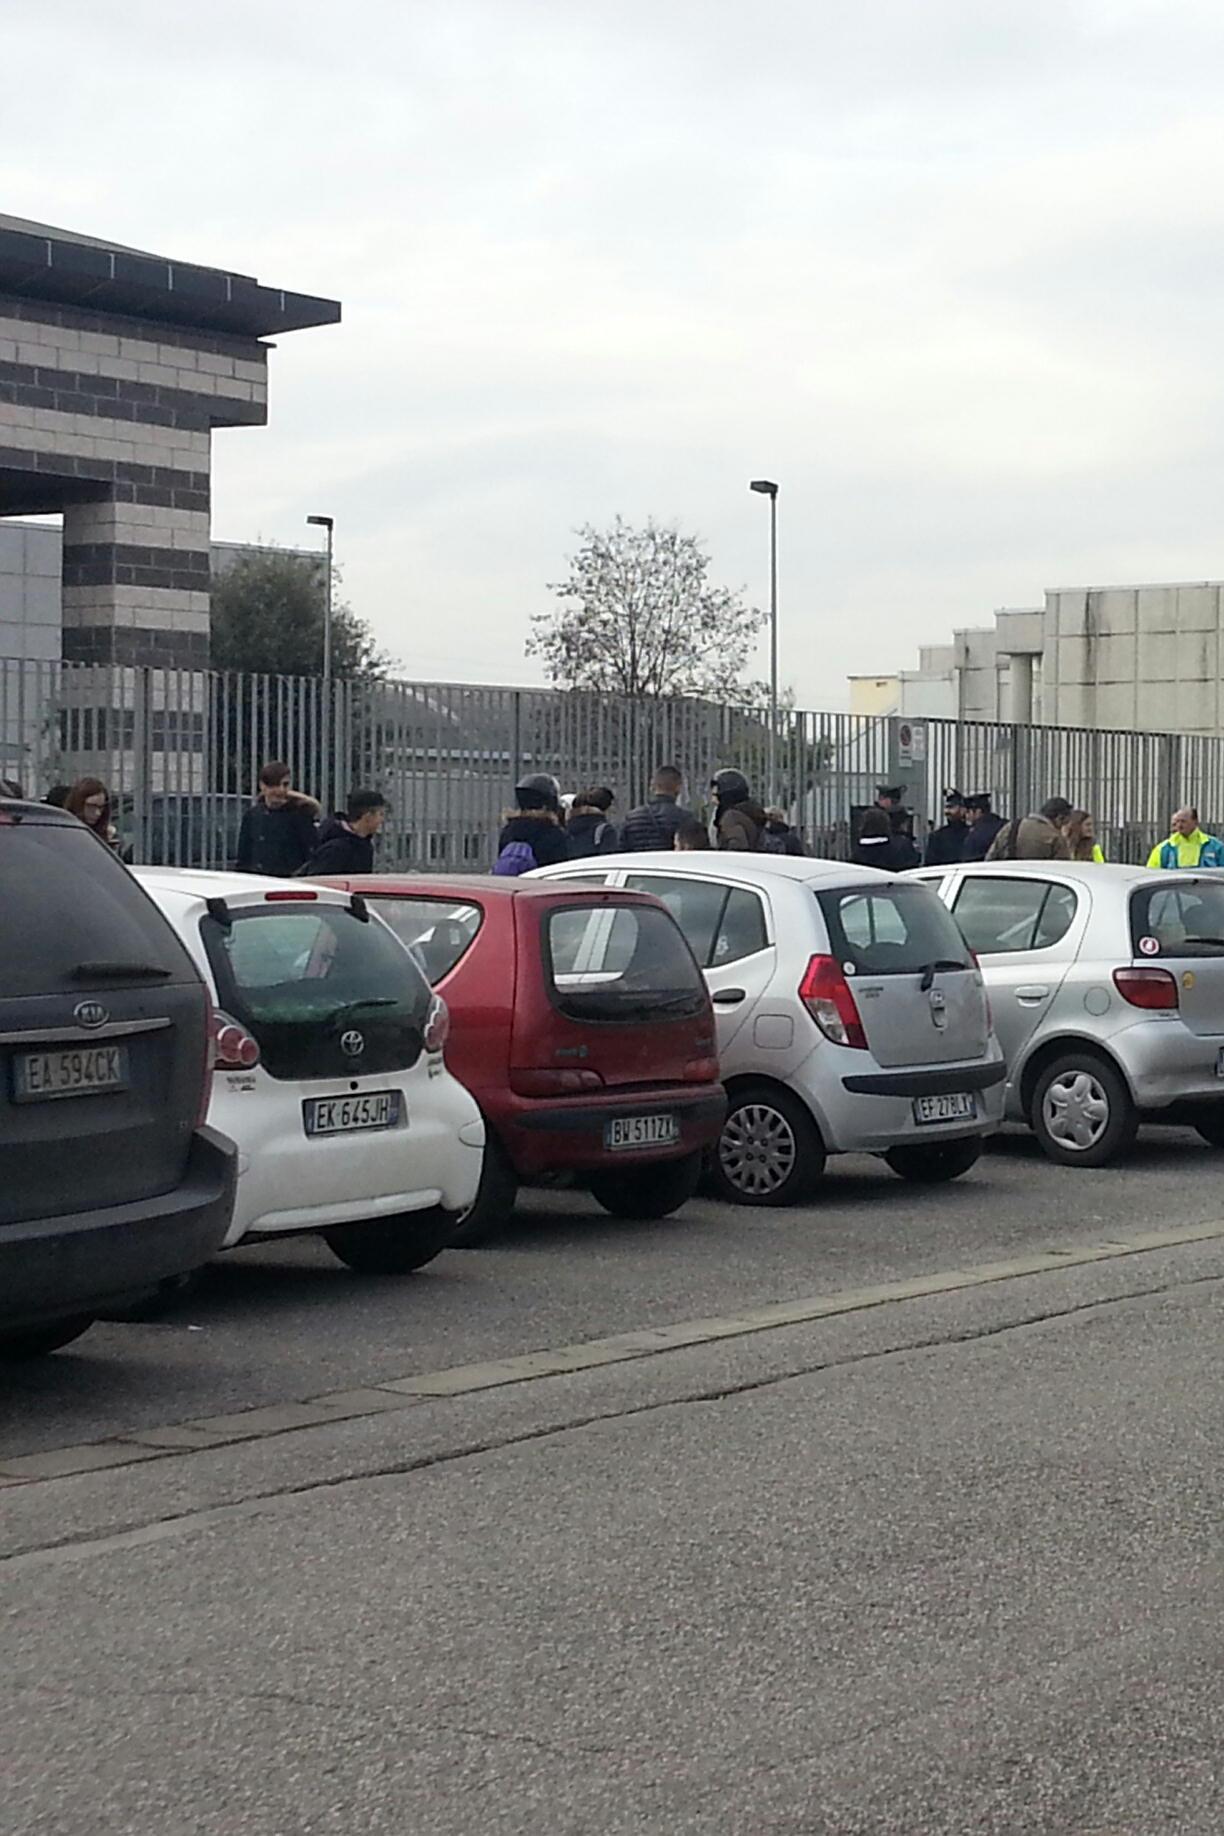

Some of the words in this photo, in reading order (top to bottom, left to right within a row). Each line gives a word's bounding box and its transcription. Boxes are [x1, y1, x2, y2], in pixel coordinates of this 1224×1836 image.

[28, 1056, 53, 1091] EA
[60, 1048, 120, 1086] 594CK
[317, 1101, 337, 1130] EK
[341, 1096, 389, 1126] 645JH
